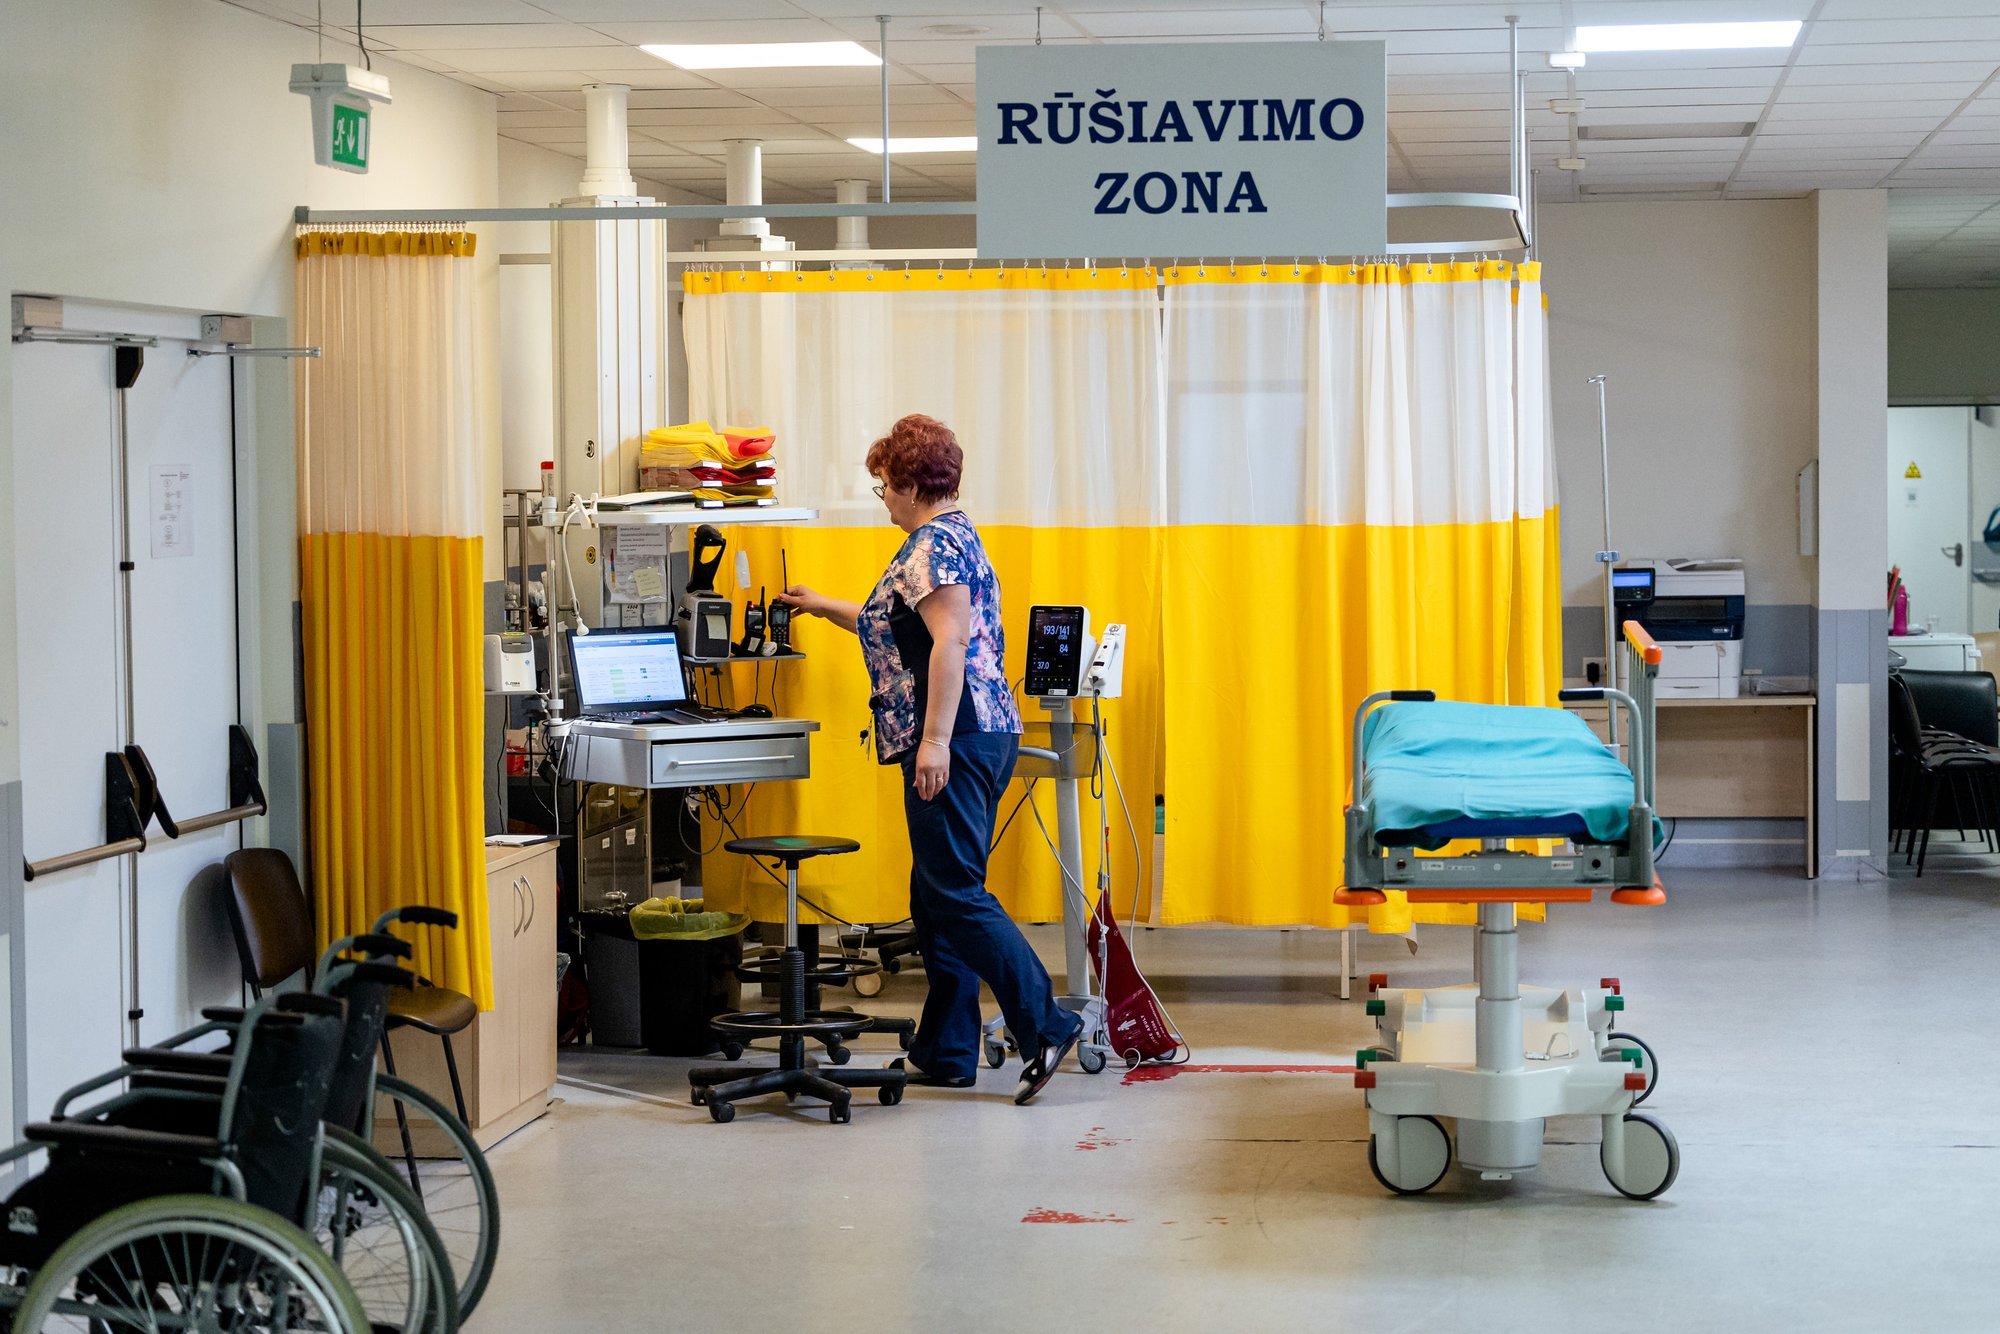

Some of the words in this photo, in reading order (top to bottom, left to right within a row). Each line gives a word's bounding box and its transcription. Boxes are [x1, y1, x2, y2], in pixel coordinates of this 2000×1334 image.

[997, 88, 1365, 145] RŪŠIAVIMO
[1094, 171, 1268, 215] ZONA
[1043, 625, 1070, 636] 193/141
[1059, 644, 1068, 653] 84
[1037, 661, 1050, 670] 37.0
[1141, 1015, 1151, 1032] ADULT
